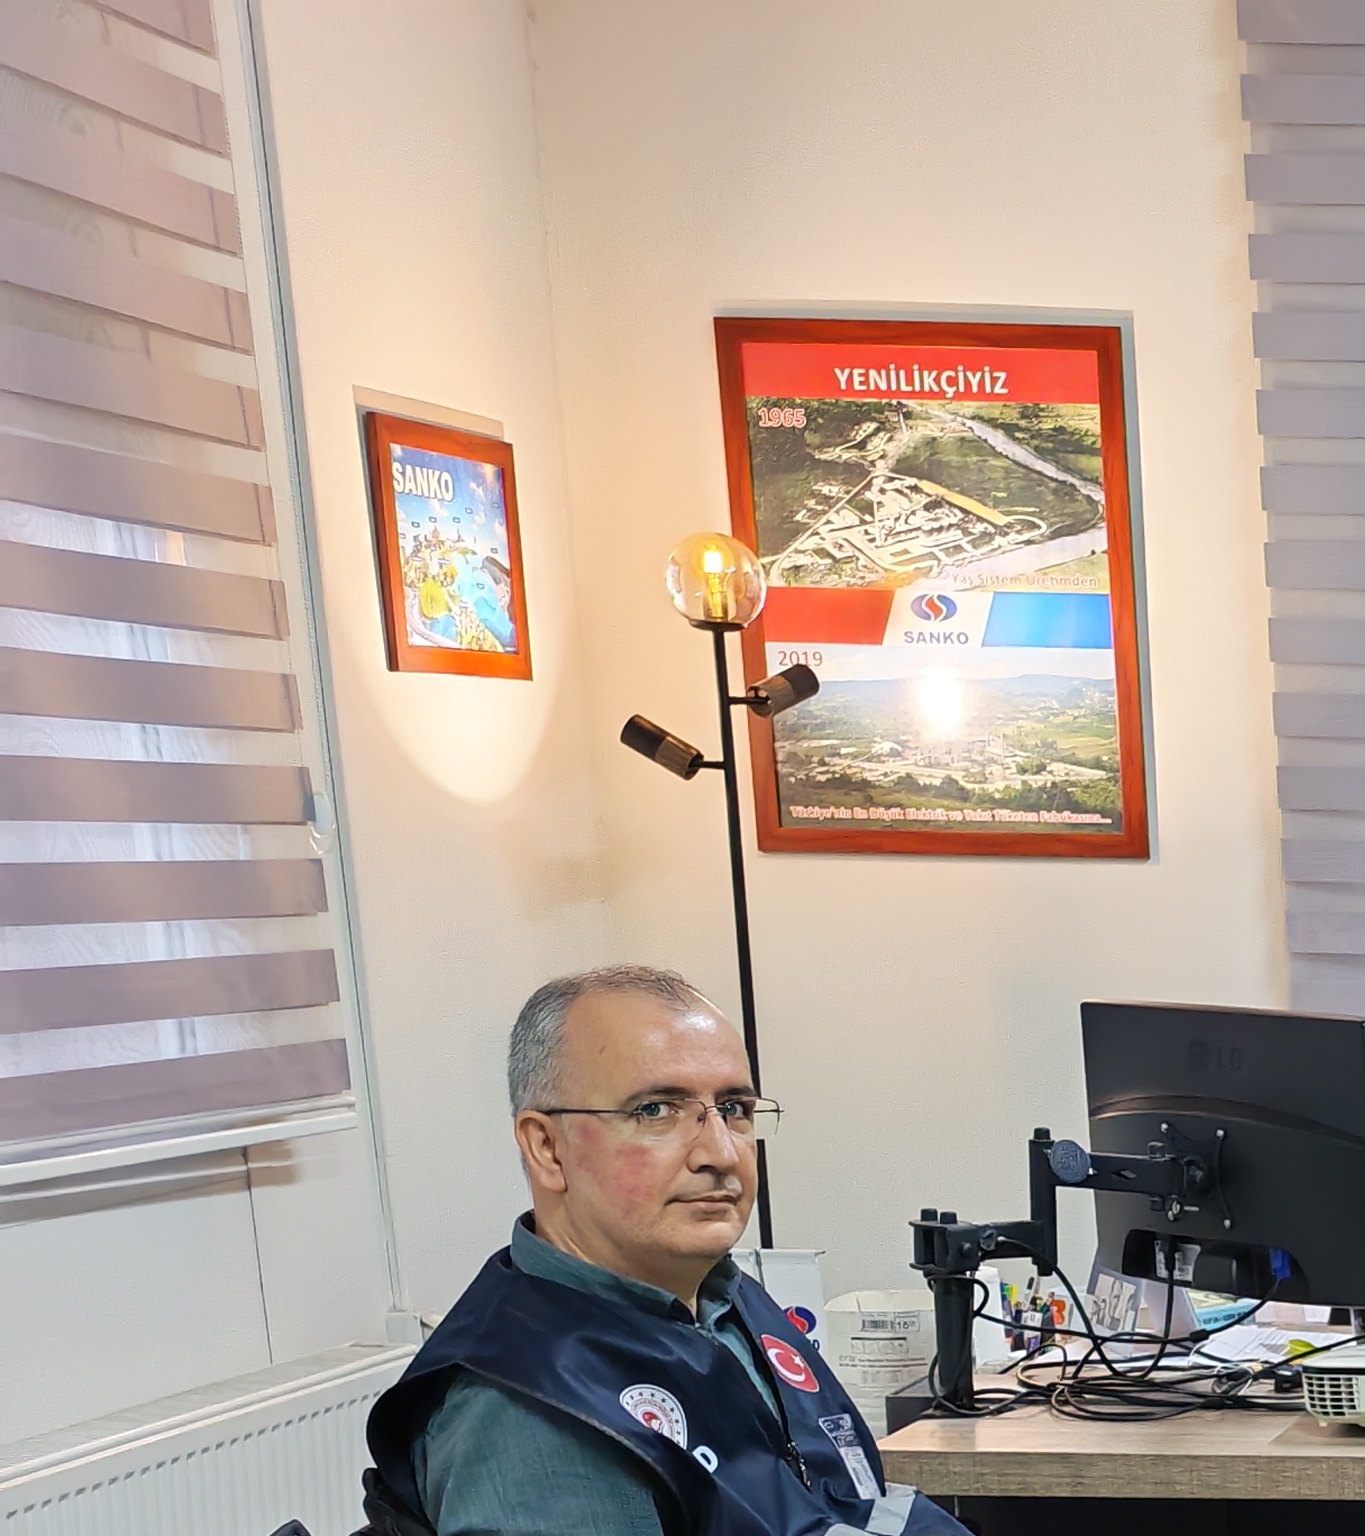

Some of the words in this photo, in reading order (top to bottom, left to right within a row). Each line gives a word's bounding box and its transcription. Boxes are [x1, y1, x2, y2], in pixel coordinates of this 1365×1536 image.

[834, 364, 1008, 398] YENİLİKÇİYİZ
[757, 407, 807, 429] 1965
[392, 461, 455, 503] SANKO
[977, 573, 1022, 586] Sistem
[903, 630, 970, 646] SANKO
[777, 648, 823, 669] 2019
